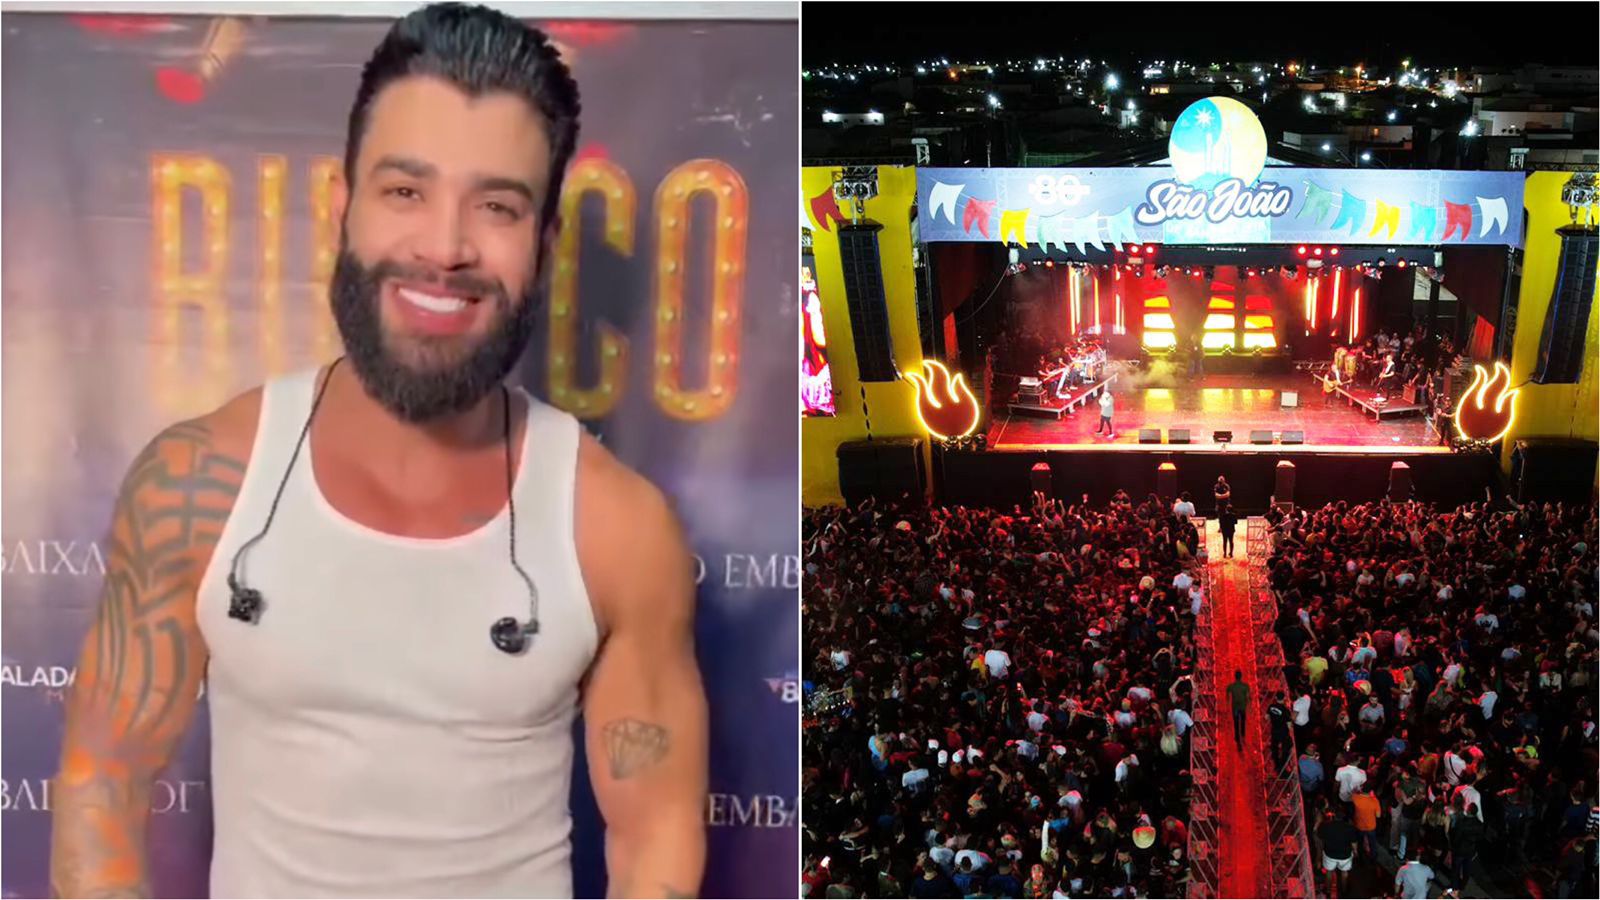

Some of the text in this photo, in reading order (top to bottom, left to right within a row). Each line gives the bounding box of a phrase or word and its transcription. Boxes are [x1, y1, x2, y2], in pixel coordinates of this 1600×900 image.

[1137, 180, 1291, 224] São João
[1, 540, 106, 575] AIXA
